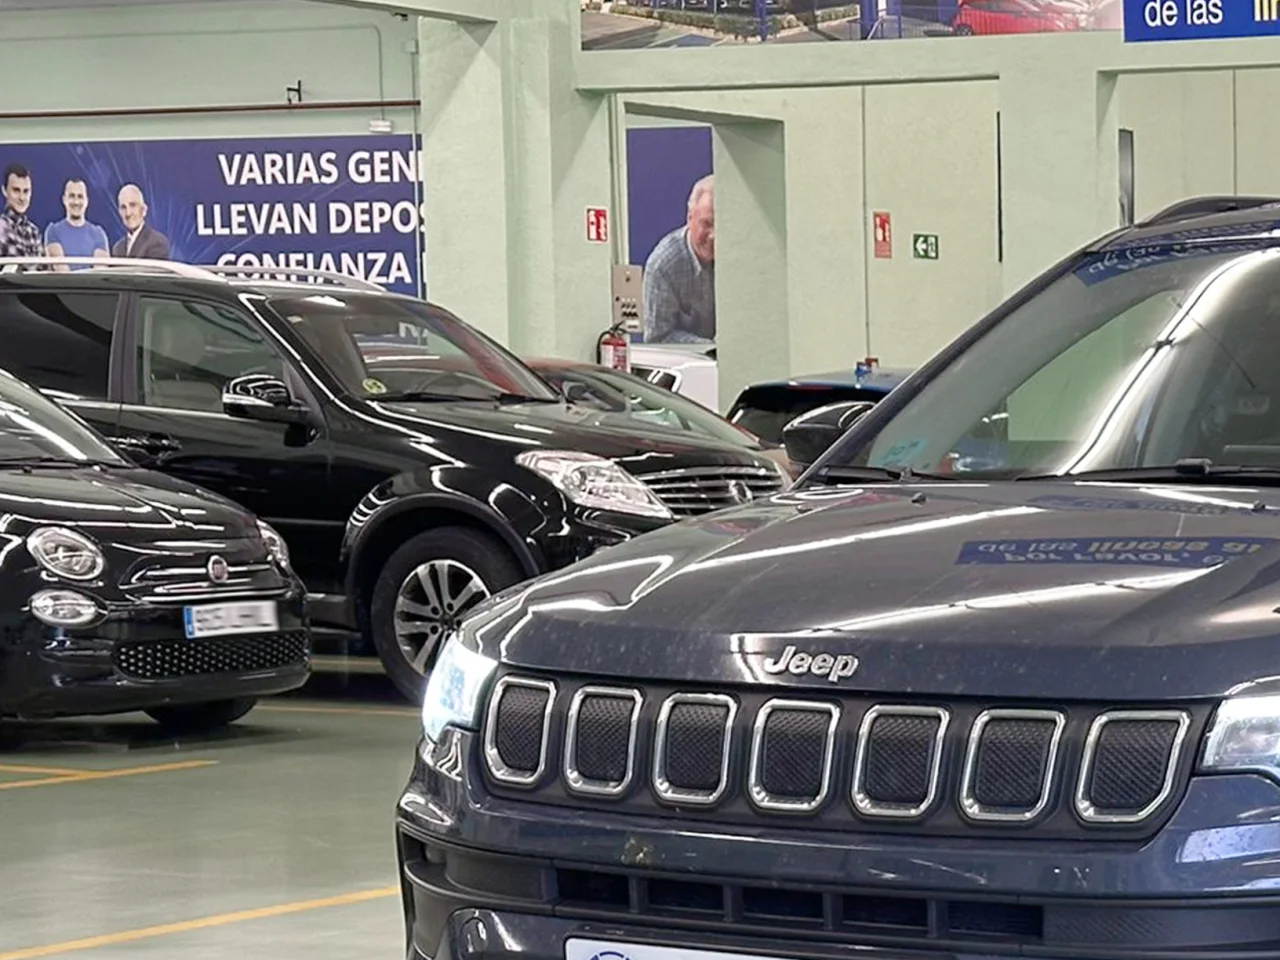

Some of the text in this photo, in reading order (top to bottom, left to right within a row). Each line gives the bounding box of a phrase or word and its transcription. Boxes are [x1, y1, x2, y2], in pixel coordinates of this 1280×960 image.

[1144, 0, 1178, 27] de
[1186, 0, 1223, 25] las
[218, 152, 339, 185] VARIAS
[196, 202, 317, 235] LLEVAN
[216, 251, 413, 284] CONFIANZA
[763, 645, 859, 682] Jeep
